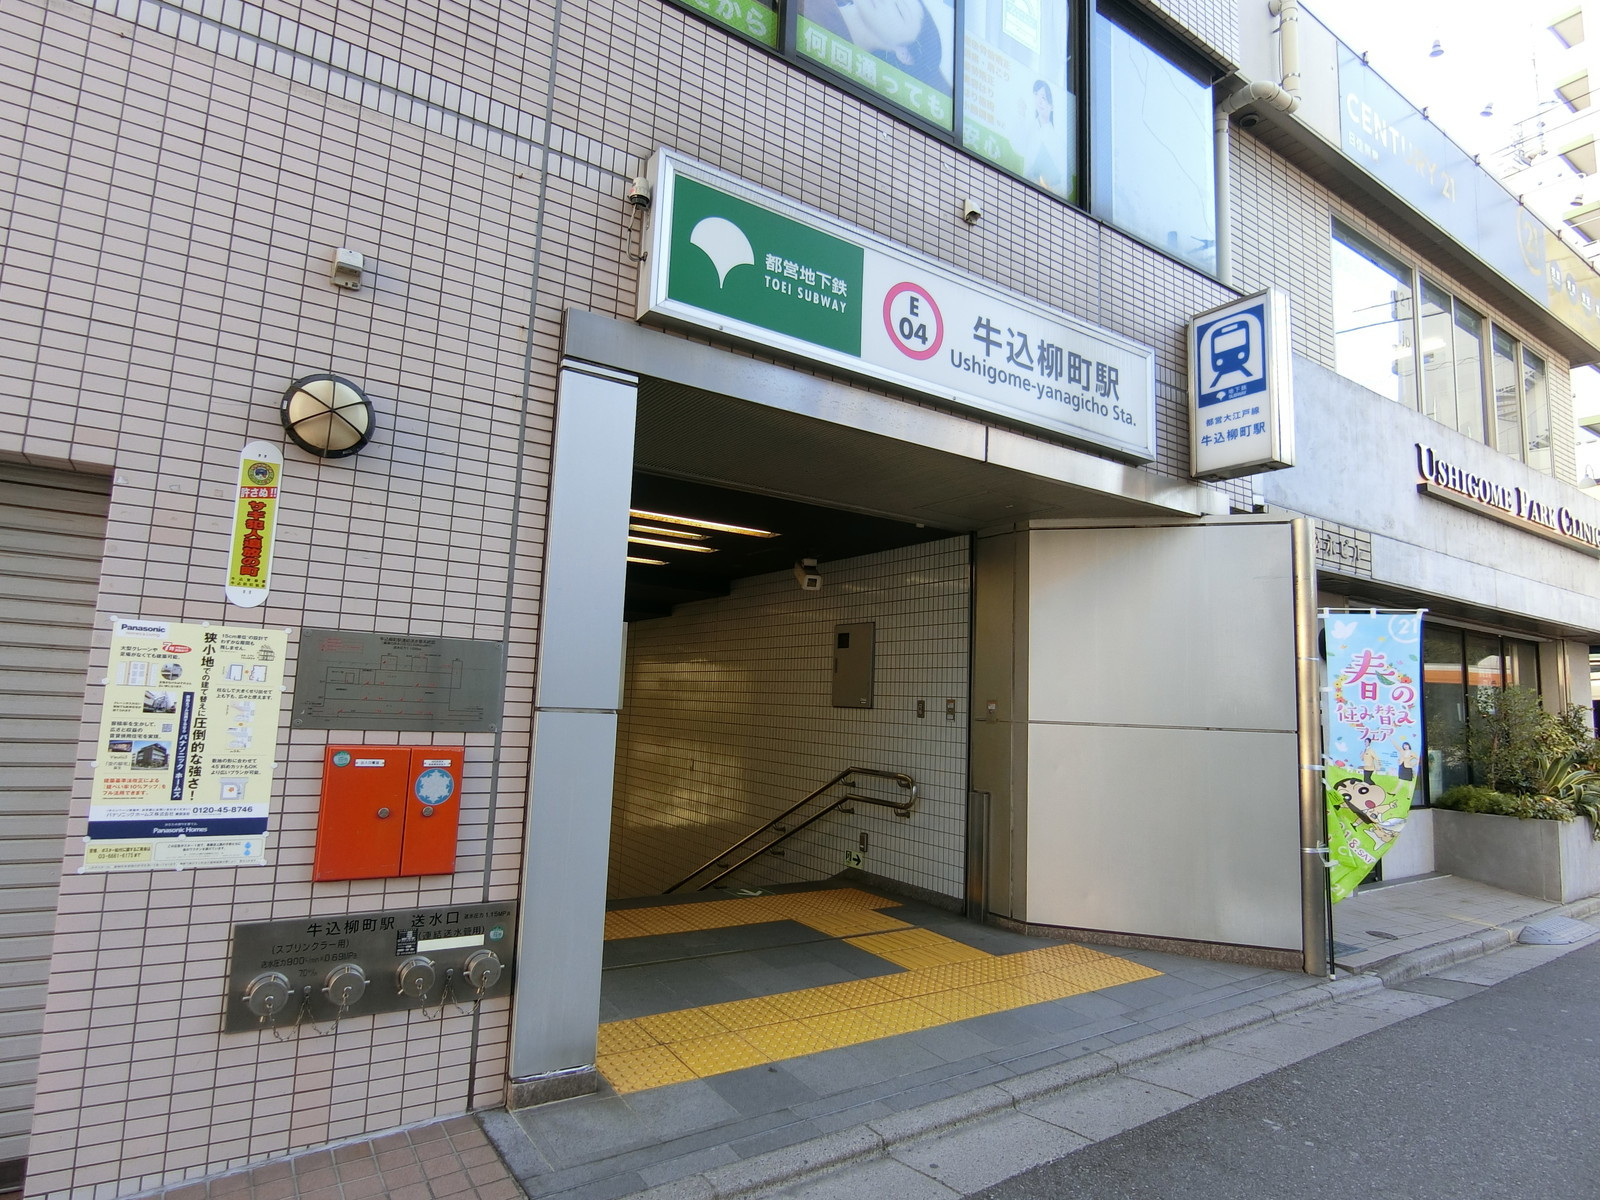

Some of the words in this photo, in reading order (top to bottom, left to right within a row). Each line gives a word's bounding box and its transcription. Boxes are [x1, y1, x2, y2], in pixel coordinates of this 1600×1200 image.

[804, 26, 944, 120] 何回通っても
[1346, 93, 1437, 186] CENTURY
[1441, 171, 1456, 203] 21
[765, 253, 848, 298] 都営地下鉄
[764, 275, 792, 295] TOEI
[797, 287, 847, 313] SUBWAY
[910, 296, 919, 317] E
[899, 316, 928, 345] 04
[973, 315, 1121, 402] 牛込柳町駅
[950, 349, 1109, 419] Ushigome-yanagicho
[1112, 402, 1137, 427] Sta.
[1206, 406, 1260, 427] 都営大江戸線
[1201, 421, 1266, 447] 牛込柳町駅
[1416, 443, 1513, 512] USHIGOME
[1515, 487, 1556, 528] PARK
[121, 623, 166, 633] Panasonic
[1398, 618, 1418, 635] 21
[1344, 649, 1416, 706] 春の
[188, 632, 218, 801] 狭小地での建て替えに圧倒的な強さ!
[1337, 703, 1413, 726] 住み替え
[1356, 725, 1394, 742] フェア
[176, 735, 188, 770] パナソニック
[172, 773, 184, 799] ホームズ
[193, 806, 253, 814] 0120-45-8746
[306, 916, 395, 938] 牛込柳町駅
[411, 911, 460, 928] 送水口
[271, 938, 350, 955] (スプリンクラー用)
